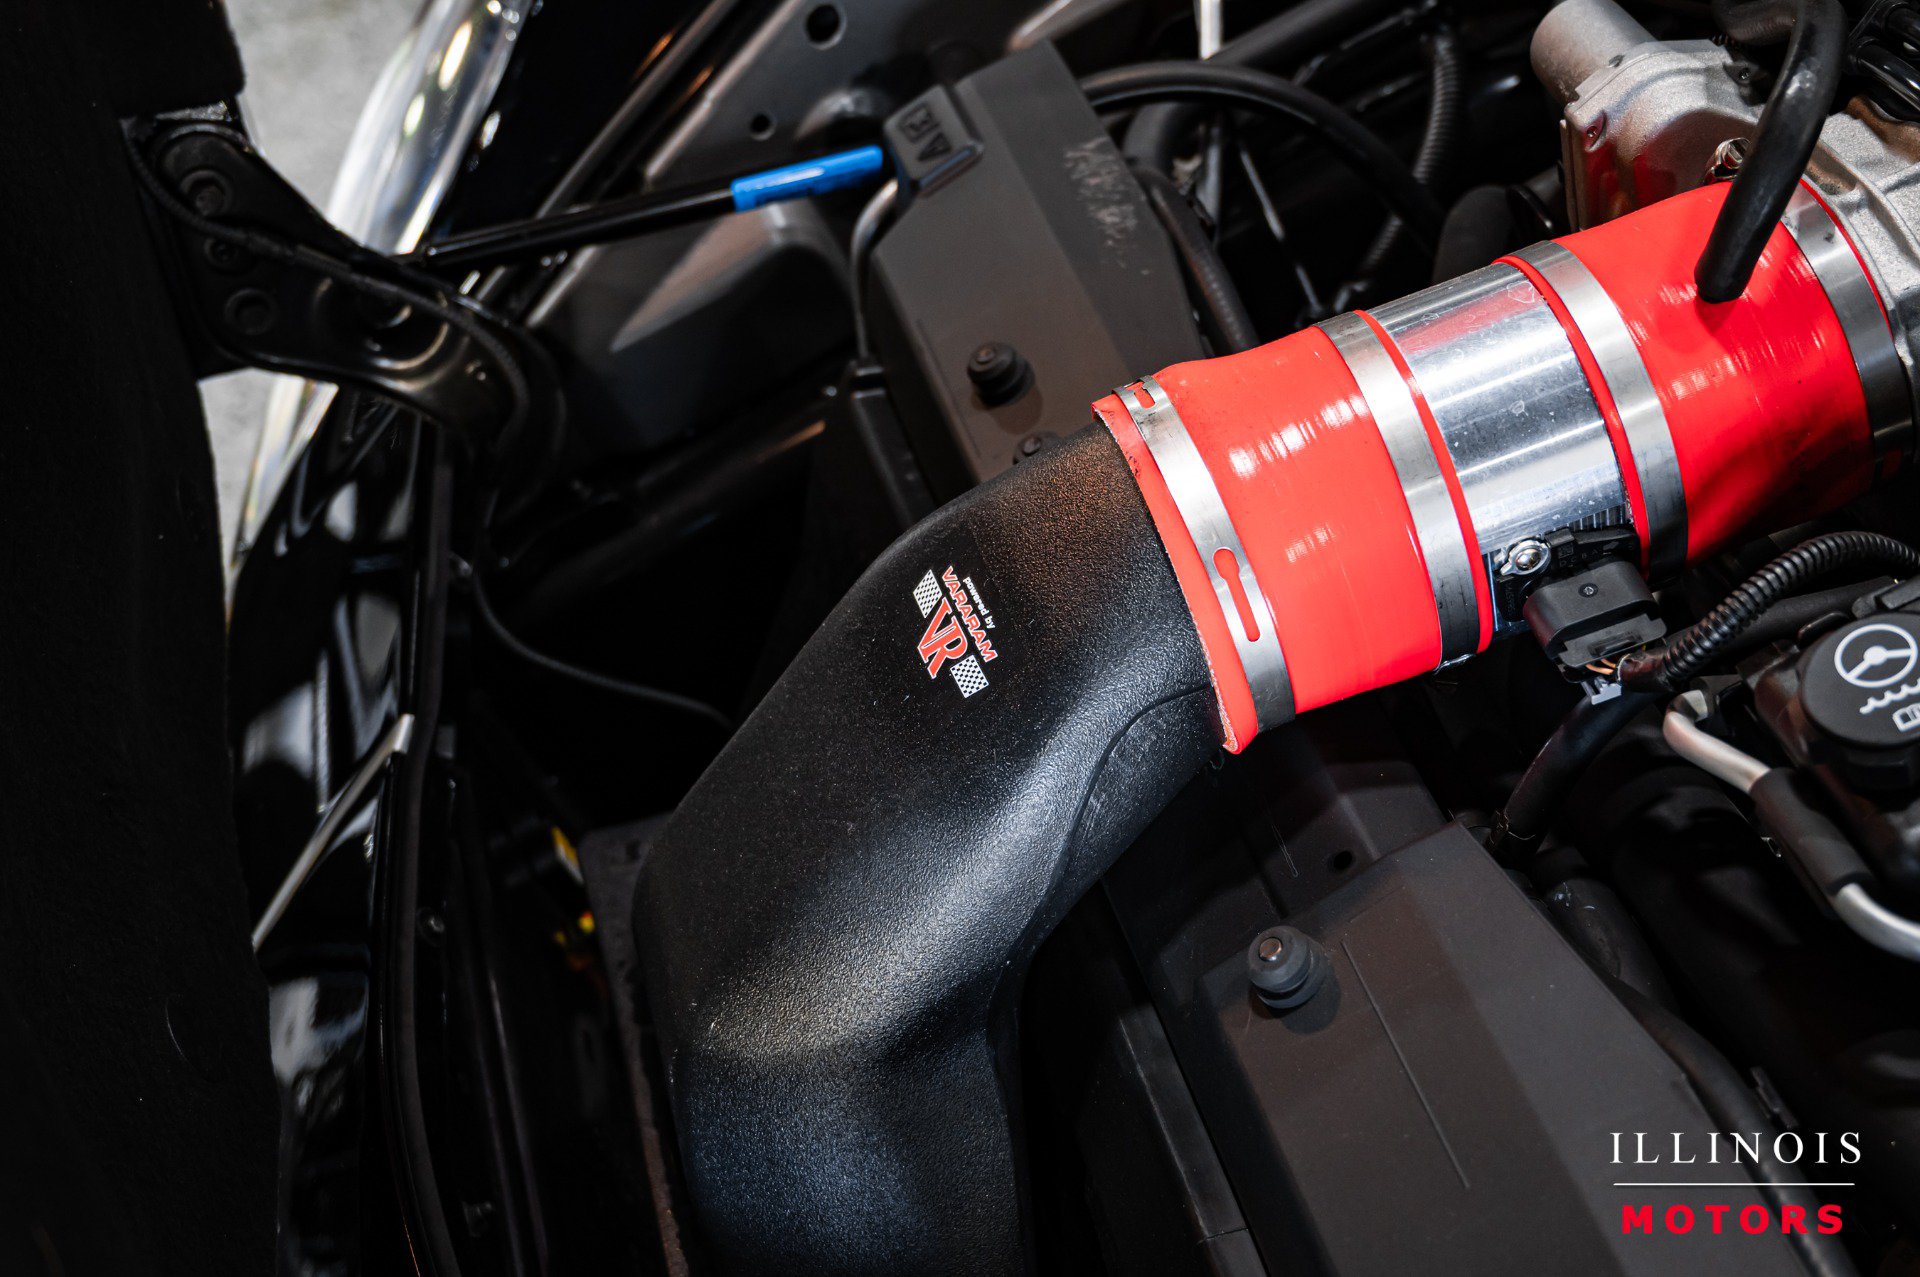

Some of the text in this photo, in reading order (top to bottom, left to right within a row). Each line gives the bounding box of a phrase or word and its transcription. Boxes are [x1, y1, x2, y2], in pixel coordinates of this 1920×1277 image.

[917, 596, 968, 679] VR
[942, 565, 998, 663] VARARAM
[963, 576, 996, 629] powered by
